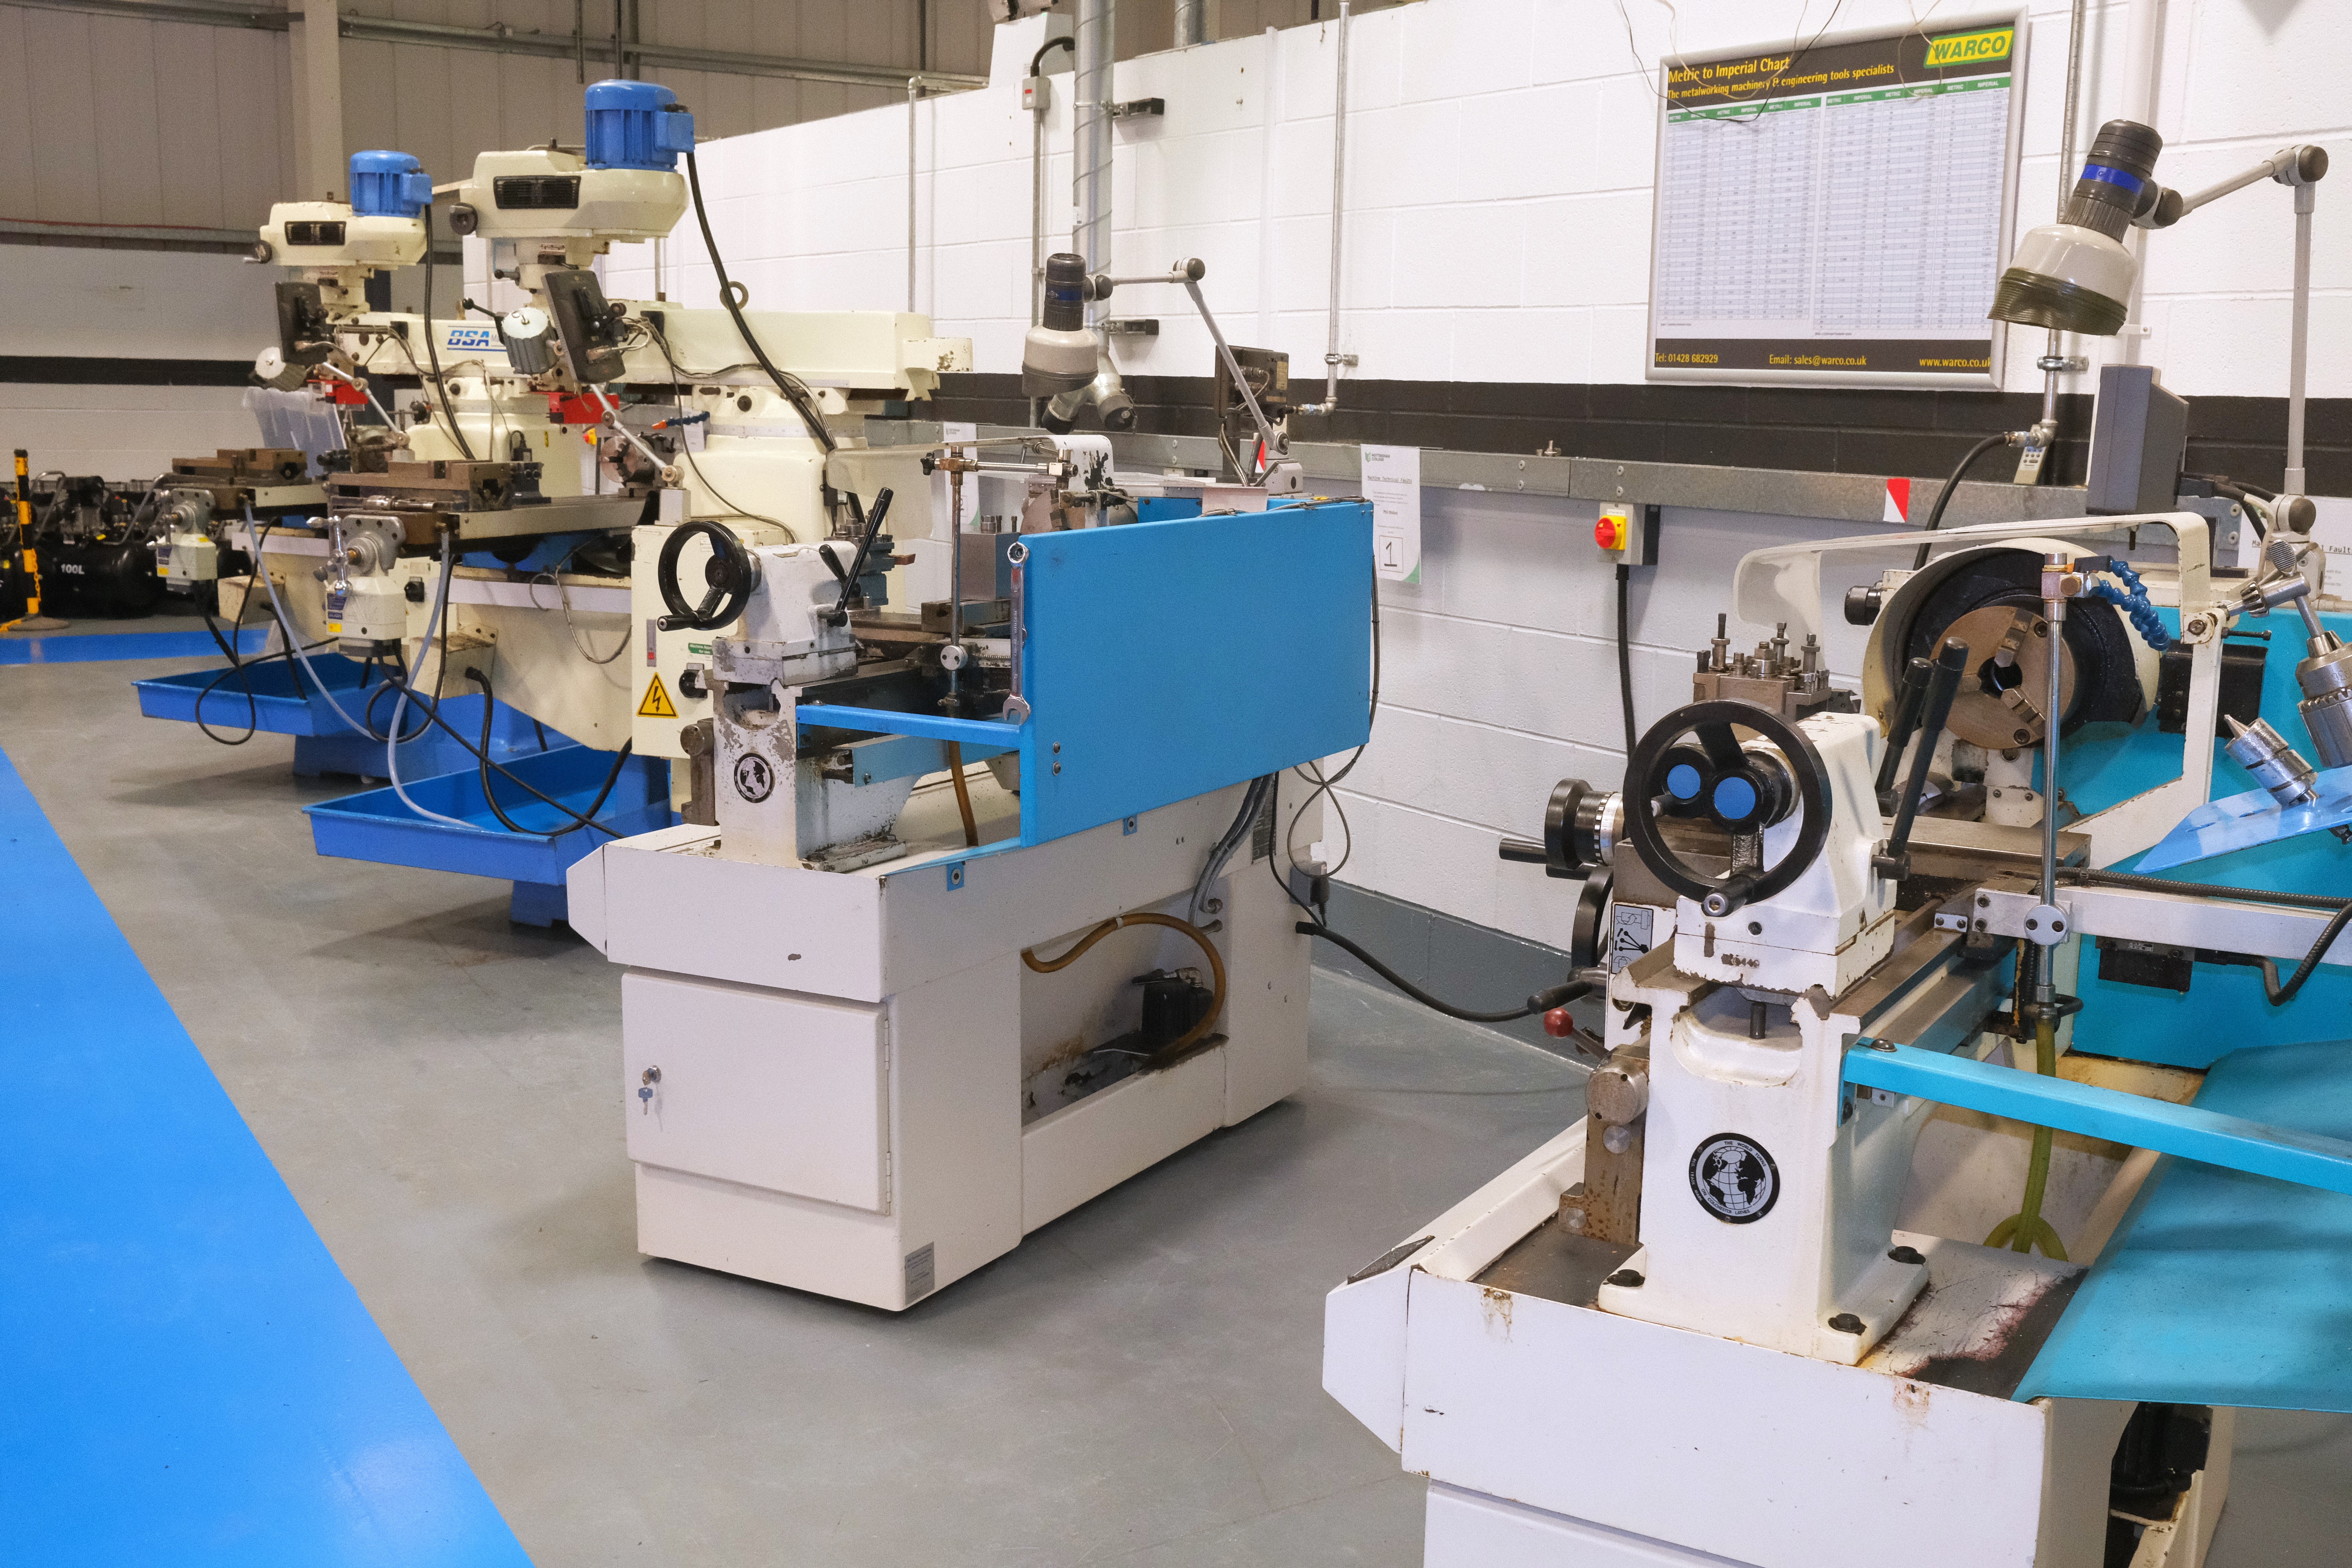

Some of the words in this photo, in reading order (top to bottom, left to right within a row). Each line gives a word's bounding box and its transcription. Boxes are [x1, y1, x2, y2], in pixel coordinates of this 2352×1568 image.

[1935, 35, 2006, 59] WARCO
[1668, 90, 1679, 99] The
[1681, 84, 1729, 98] metalworking
[1732, 80, 1770, 90] machinery
[1773, 78, 1779, 87] &
[1781, 72, 1828, 88] engineering
[1830, 69, 1850, 80] tools
[1853, 64, 1894, 80] specialists
[1669, 67, 1700, 83] Metric
[1703, 67, 1713, 78] to
[1716, 60, 1757, 79] Imperial
[1760, 57, 1790, 72] Chart
[447, 330, 490, 346] BSA
[1655, 353, 1666, 362] Tel:
[1668, 354, 1690, 363] 01428
[1692, 354, 1718, 363] 682929
[1769, 354, 1792, 364] Email:
[1794, 354, 1867, 366] sales@warco.co.uk
[1384, 541, 1397, 567] 1
[61, 564, 85, 575] 100L
[1737, 1142, 1753, 1152] WORLD
[1755, 1153, 1766, 1167] TURNS
[1708, 1197, 1732, 1214] COLCHESTER
